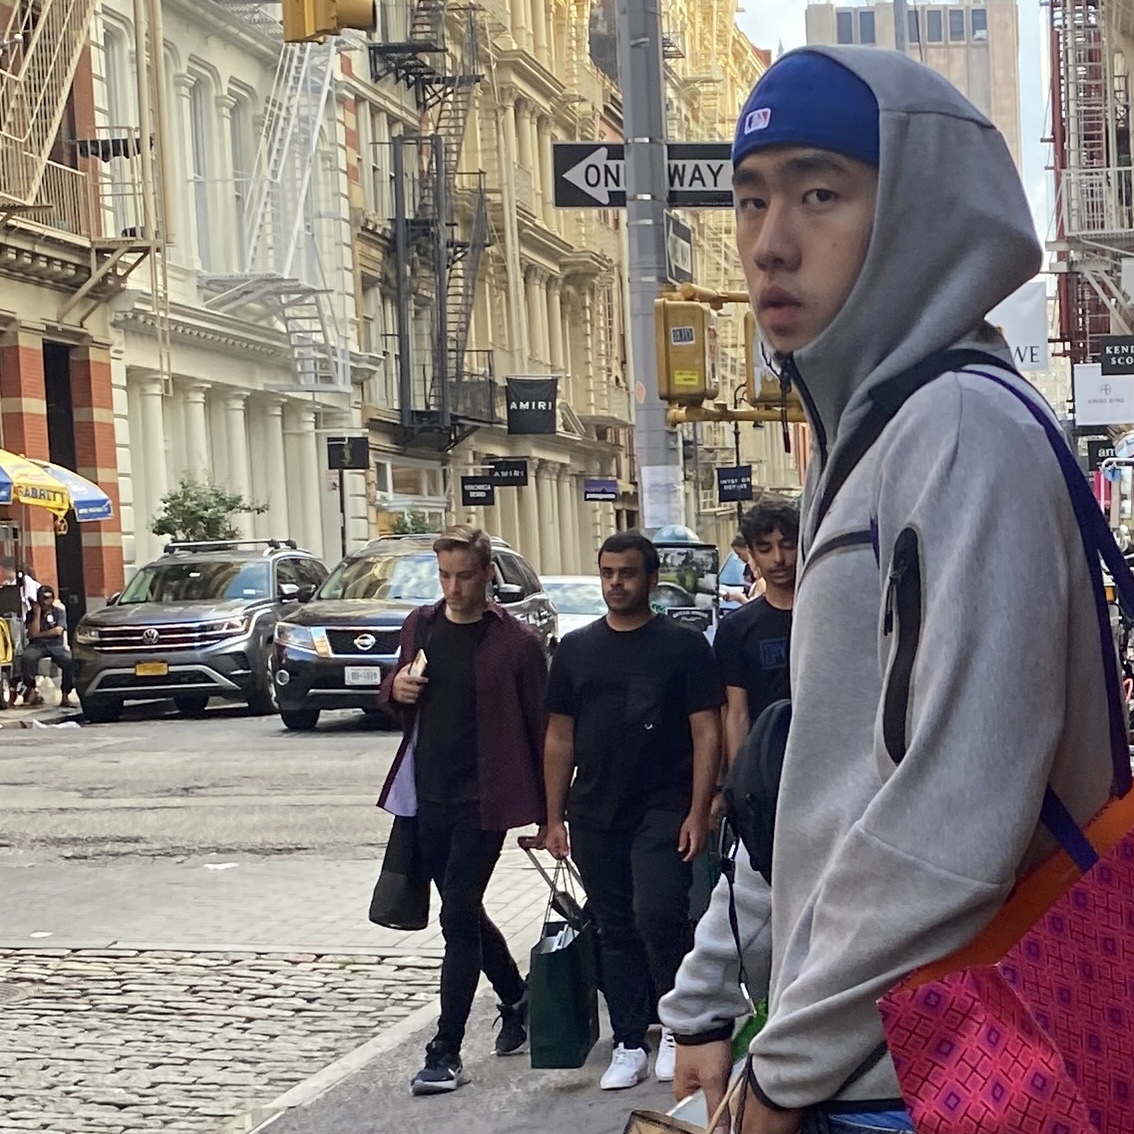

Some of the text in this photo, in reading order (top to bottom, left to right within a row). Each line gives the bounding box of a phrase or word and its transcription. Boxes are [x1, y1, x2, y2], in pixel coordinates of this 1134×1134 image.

[584, 163, 724, 188] ON WAY
[509, 401, 553, 411] AMIRI
